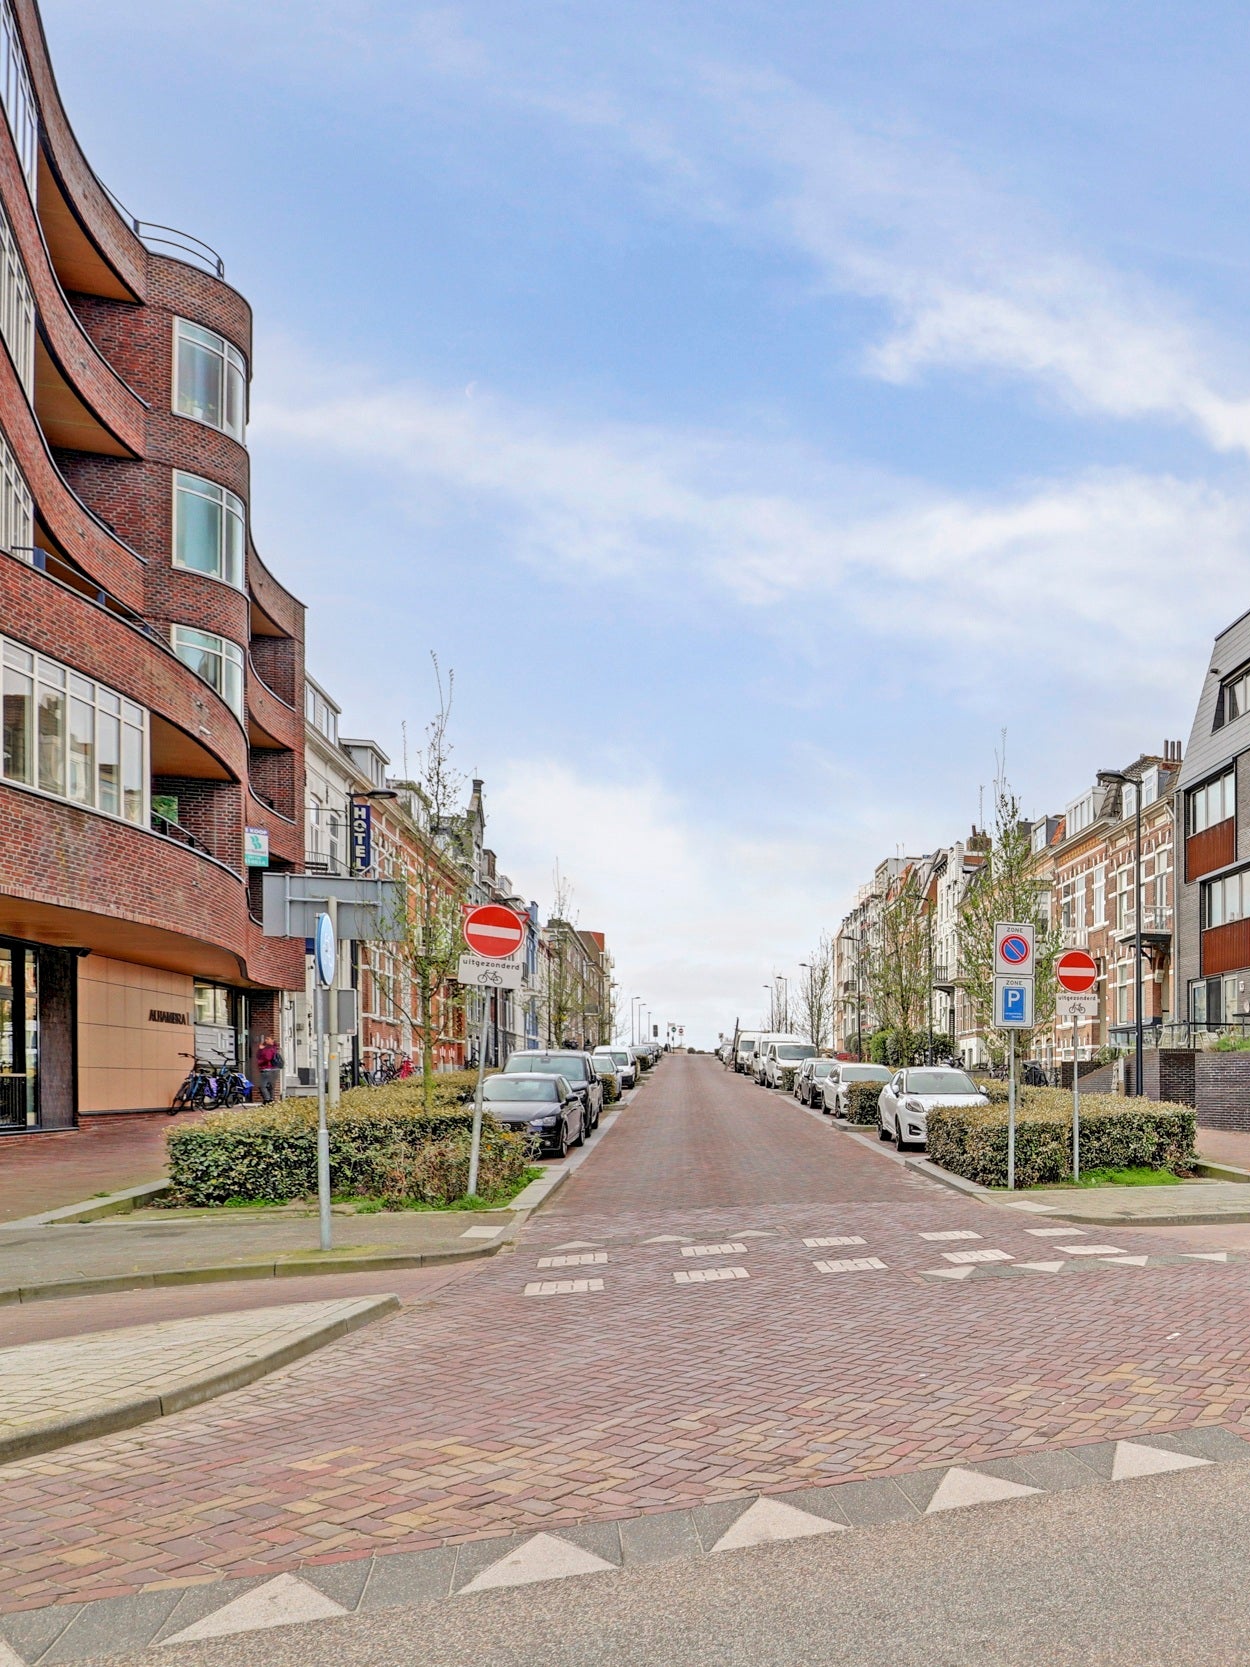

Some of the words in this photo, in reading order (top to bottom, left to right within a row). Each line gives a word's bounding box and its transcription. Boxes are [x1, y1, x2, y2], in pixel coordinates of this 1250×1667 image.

[353, 807, 367, 870] HOTEL
[462, 958, 520, 971] uitgezonderd
[1008, 990, 1020, 1008] P
[148, 1009, 187, 1026] ALHAMBRA
